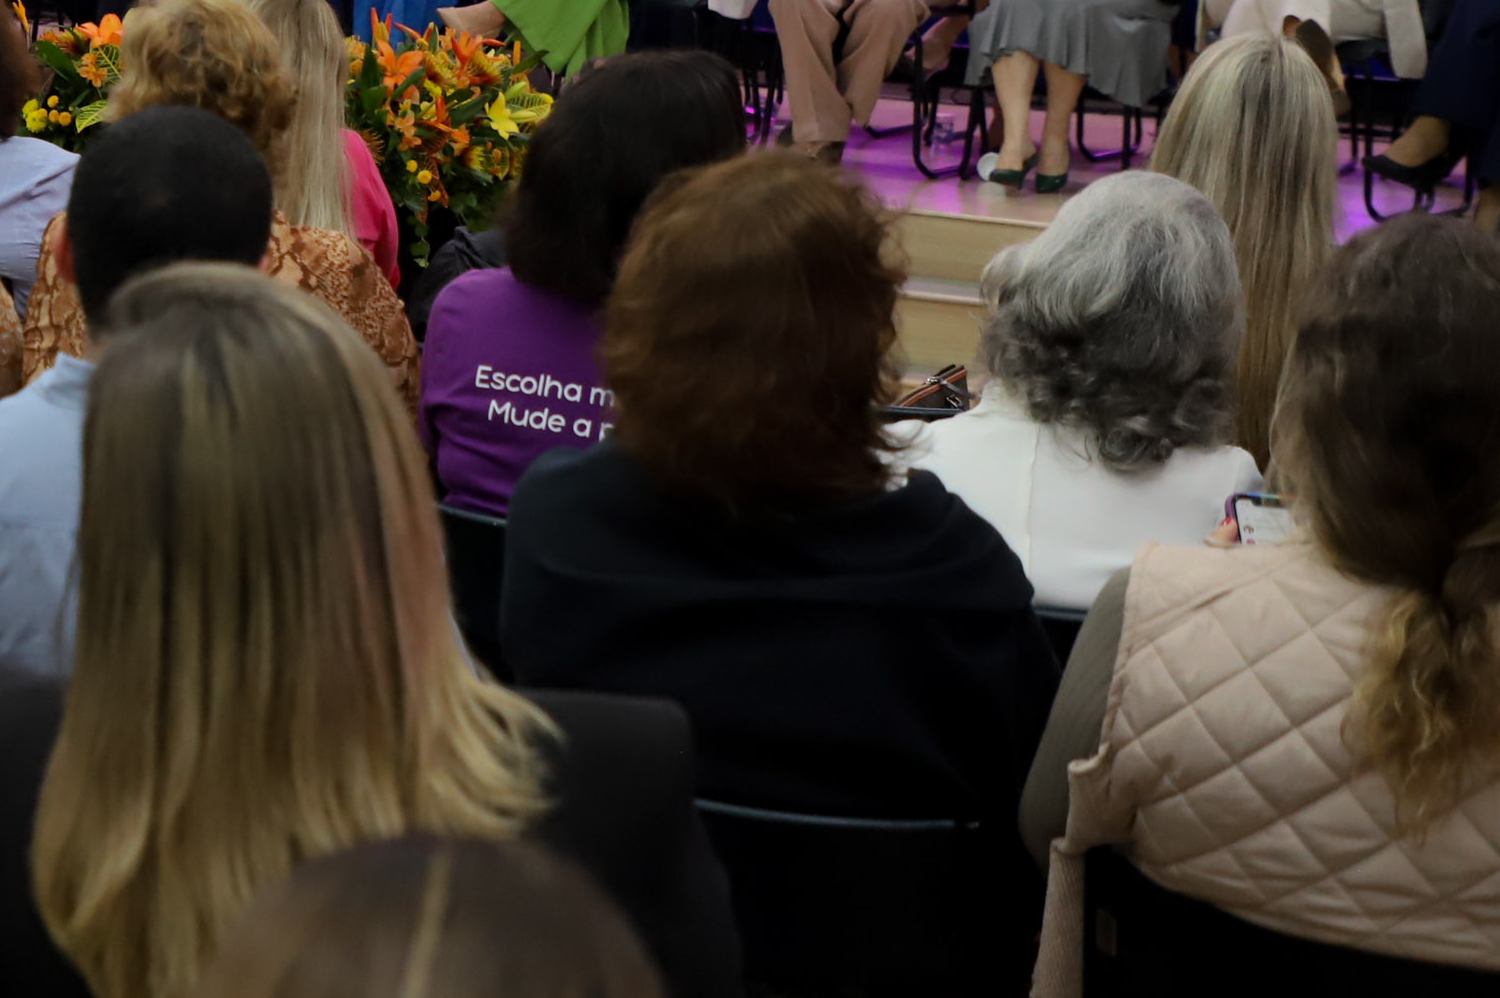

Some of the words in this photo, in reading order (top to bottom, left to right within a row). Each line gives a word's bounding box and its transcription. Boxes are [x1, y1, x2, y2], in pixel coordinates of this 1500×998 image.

[475, 365, 583, 403] Escolha
[488, 399, 565, 433] Mude
[573, 419, 592, 438] a
